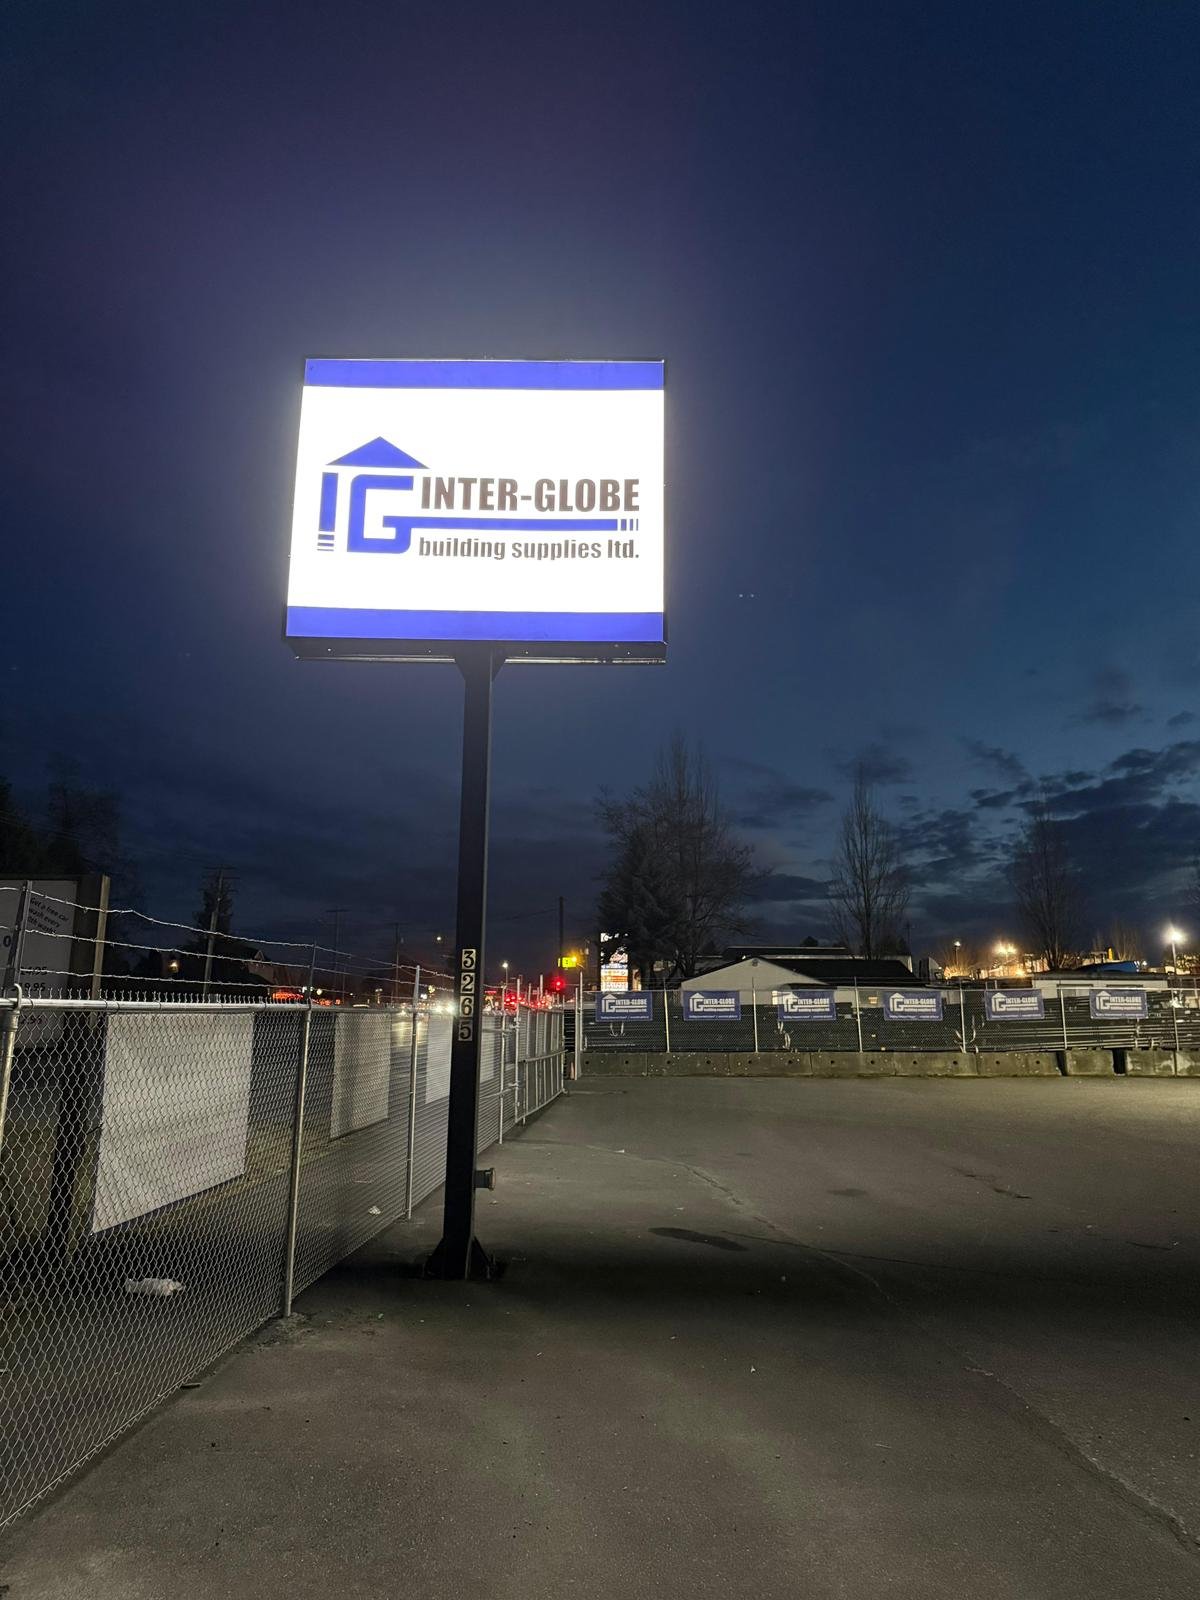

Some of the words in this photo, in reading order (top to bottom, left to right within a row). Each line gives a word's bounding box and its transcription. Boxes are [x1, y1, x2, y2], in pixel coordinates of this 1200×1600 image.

[421, 476, 640, 512] INTER-GLOBE
[418, 537, 506, 560] building
[511, 539, 602, 561] supplies
[607, 540, 640, 559] ltd.
[459, 950, 476, 1040] 3265
